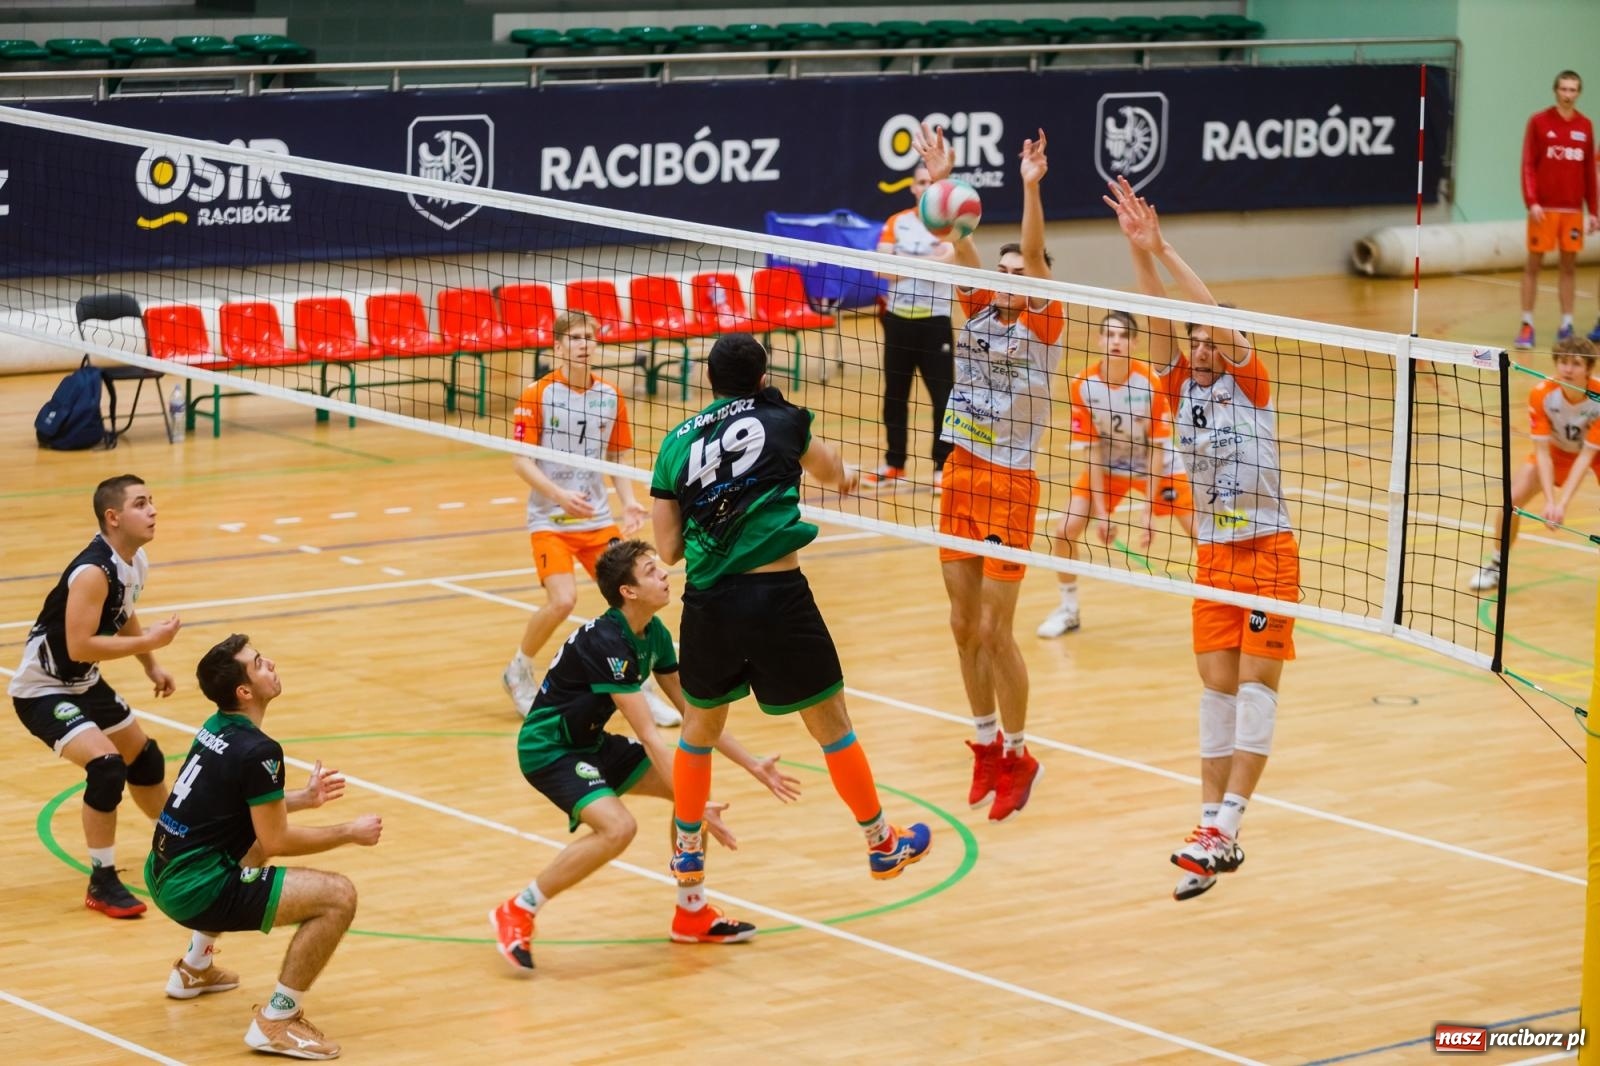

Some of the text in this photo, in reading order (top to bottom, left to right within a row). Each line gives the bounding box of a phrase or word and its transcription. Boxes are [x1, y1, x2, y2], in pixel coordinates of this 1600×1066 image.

[1201, 103, 1395, 161] RACIBÓRZ
[540, 126, 780, 192] RACIBÓRZ
[197, 200, 292, 226] RACIBÓRZ
[1113, 414, 1124, 433] 2
[1192, 405, 1207, 429] 8
[577, 420, 587, 444] 7
[1565, 424, 1582, 441] 12
[685, 416, 766, 489] 49
[172, 753, 203, 809] 4
